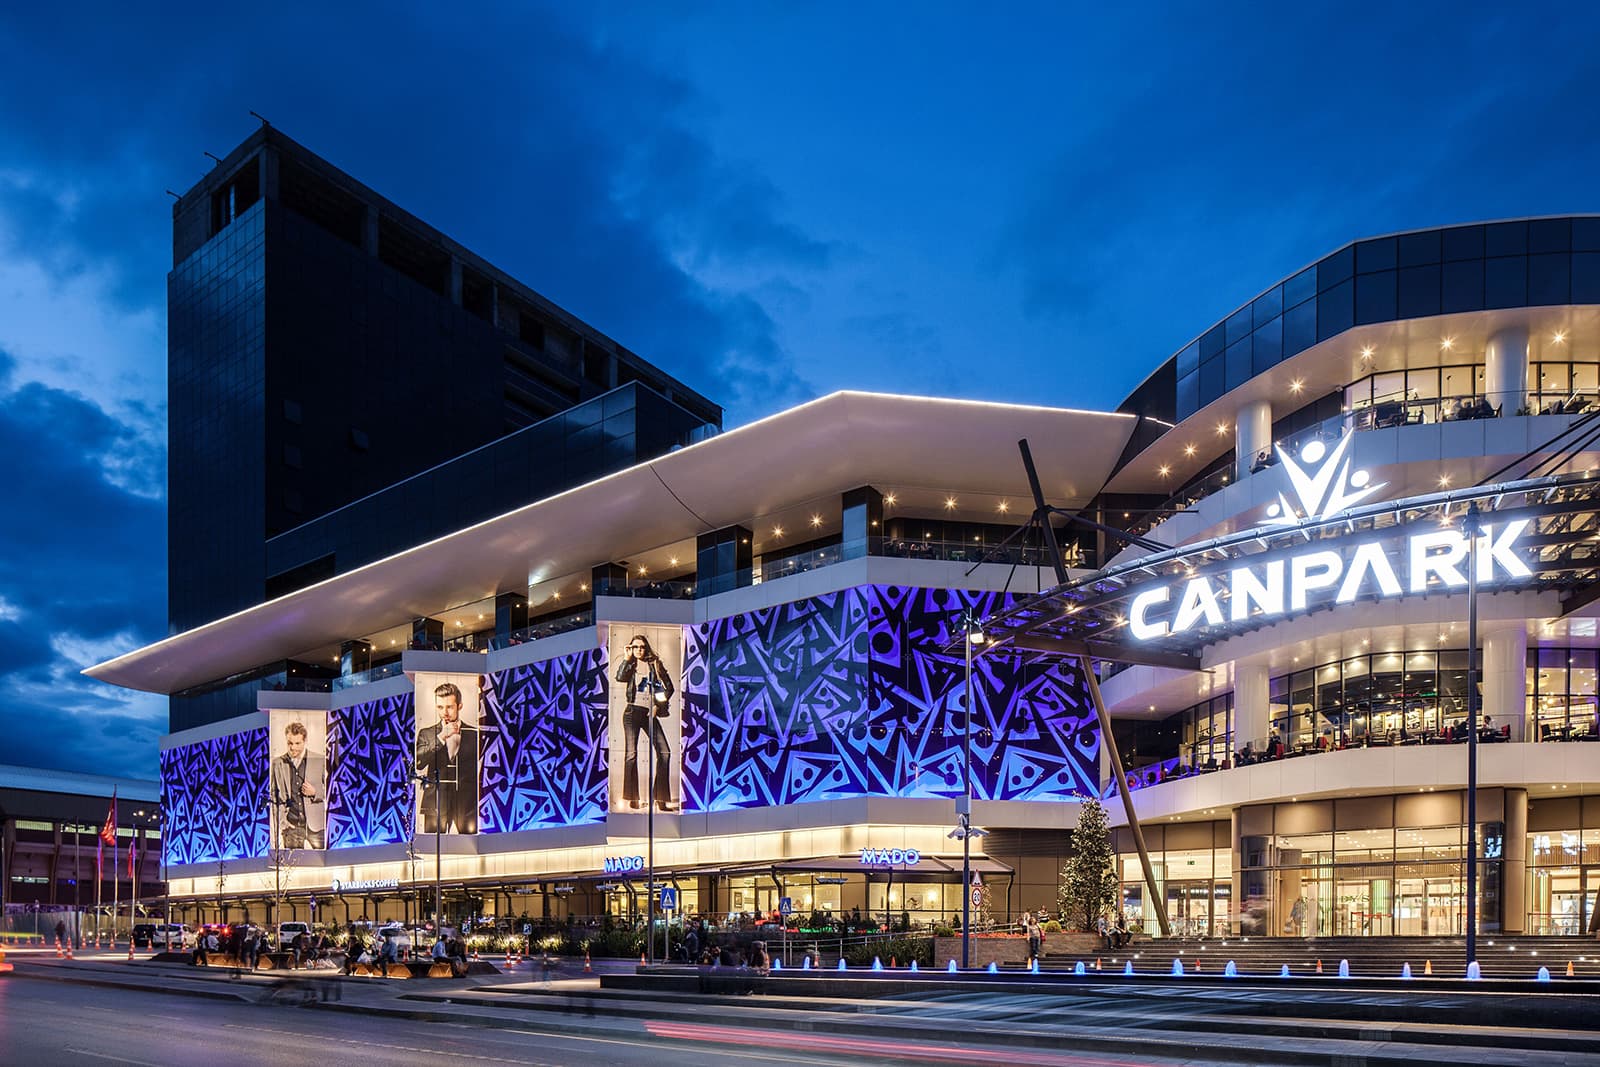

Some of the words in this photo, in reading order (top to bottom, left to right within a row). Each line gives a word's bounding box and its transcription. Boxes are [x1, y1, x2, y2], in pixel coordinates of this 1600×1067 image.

[1129, 518, 1533, 642] CANPARK
[604, 856, 644, 873] MADO
[860, 847, 920, 866] MADO
